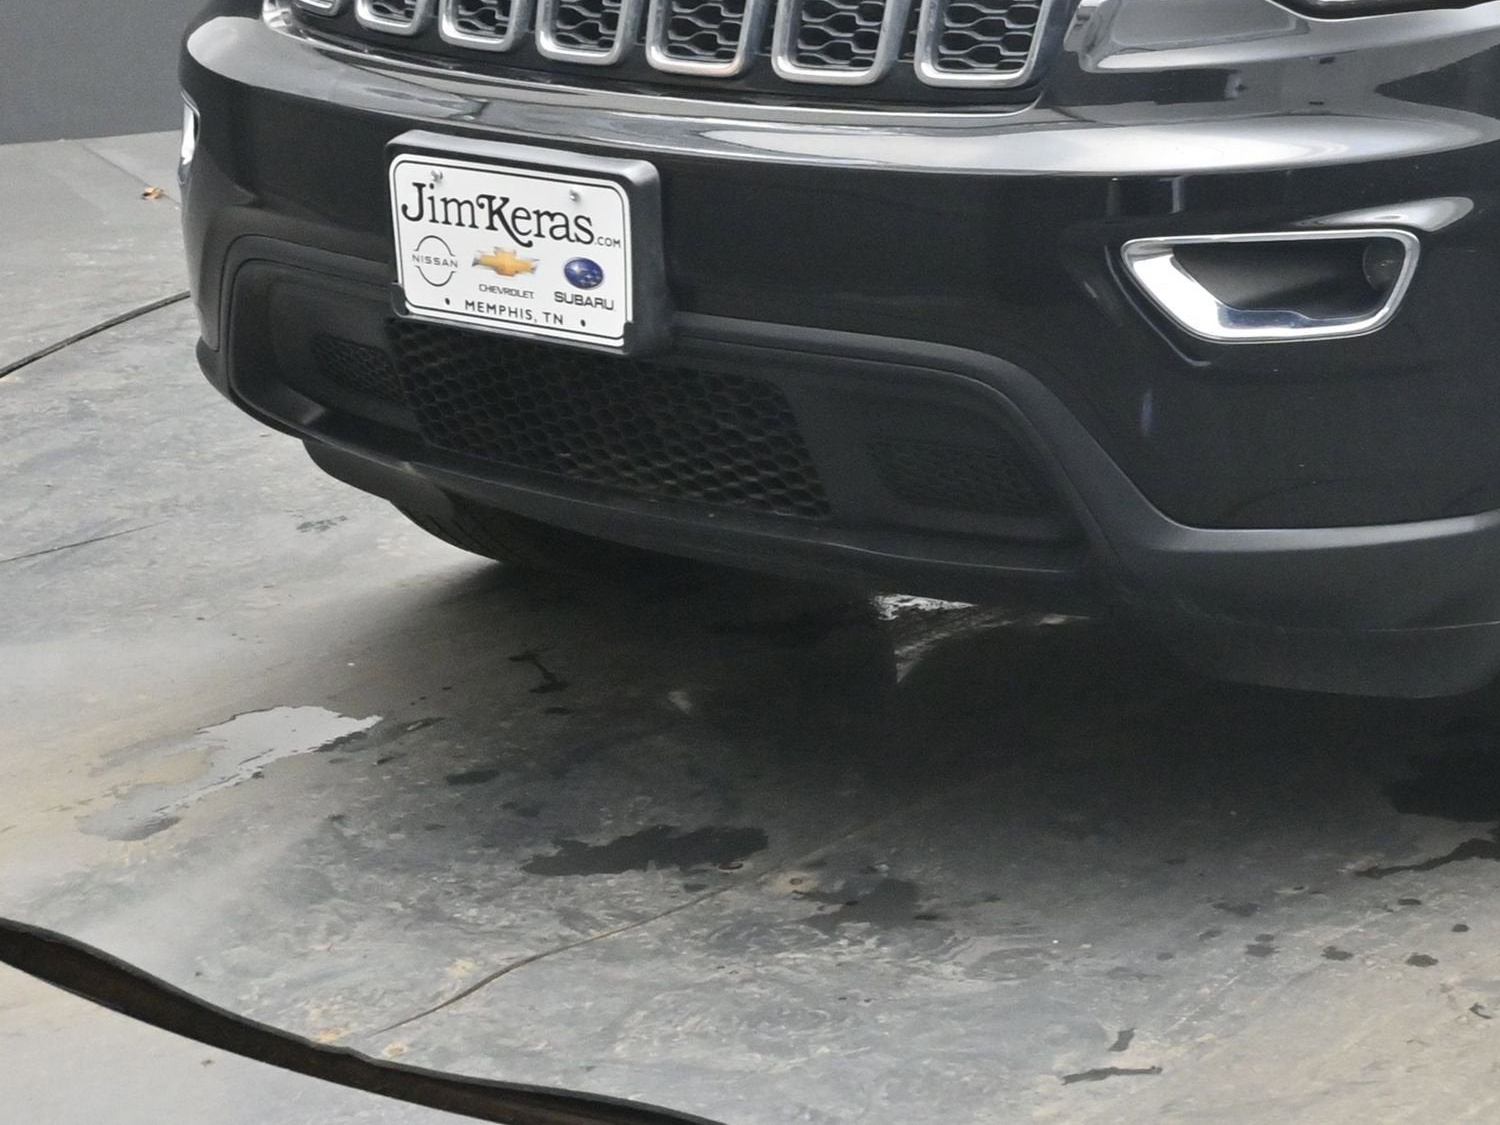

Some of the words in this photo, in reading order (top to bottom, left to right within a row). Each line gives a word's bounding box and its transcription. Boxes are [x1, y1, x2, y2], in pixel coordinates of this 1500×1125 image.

[412, 254, 458, 268] NISSAN
[478, 283, 535, 300] CHEVROLET
[554, 291, 614, 311] SUBARU
[464, 299, 538, 323] MEMPHIS,
[542, 311, 564, 325] TN
